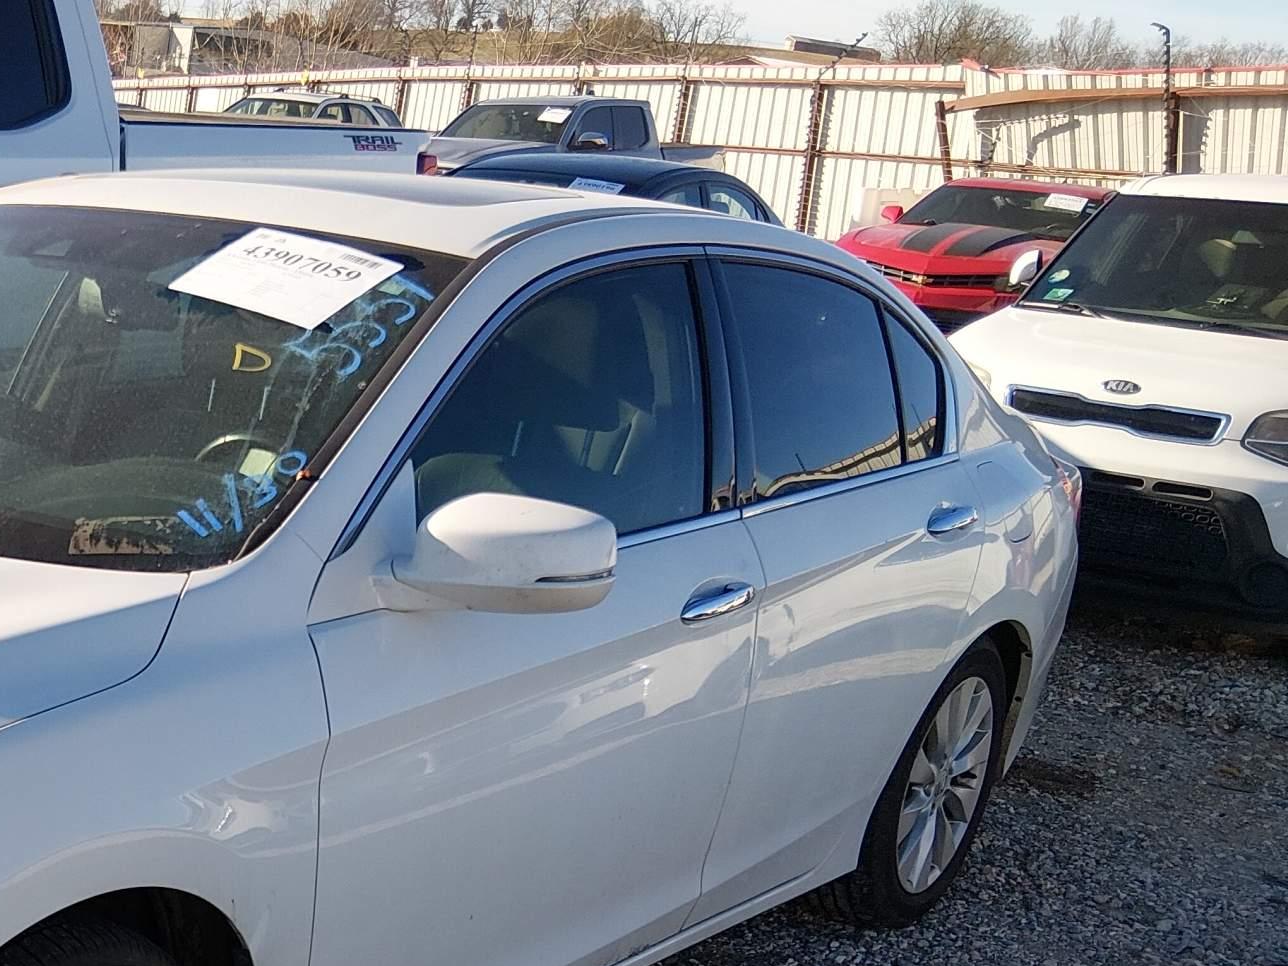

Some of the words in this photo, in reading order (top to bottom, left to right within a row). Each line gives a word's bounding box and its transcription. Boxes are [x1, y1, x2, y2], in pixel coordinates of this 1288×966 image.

[343, 134, 404, 146] TRAIL
[353, 143, 398, 152] BOSS
[243, 245, 363, 282] 43907059
[231, 342, 272, 371] D
[1106, 380, 1135, 393] KIA
